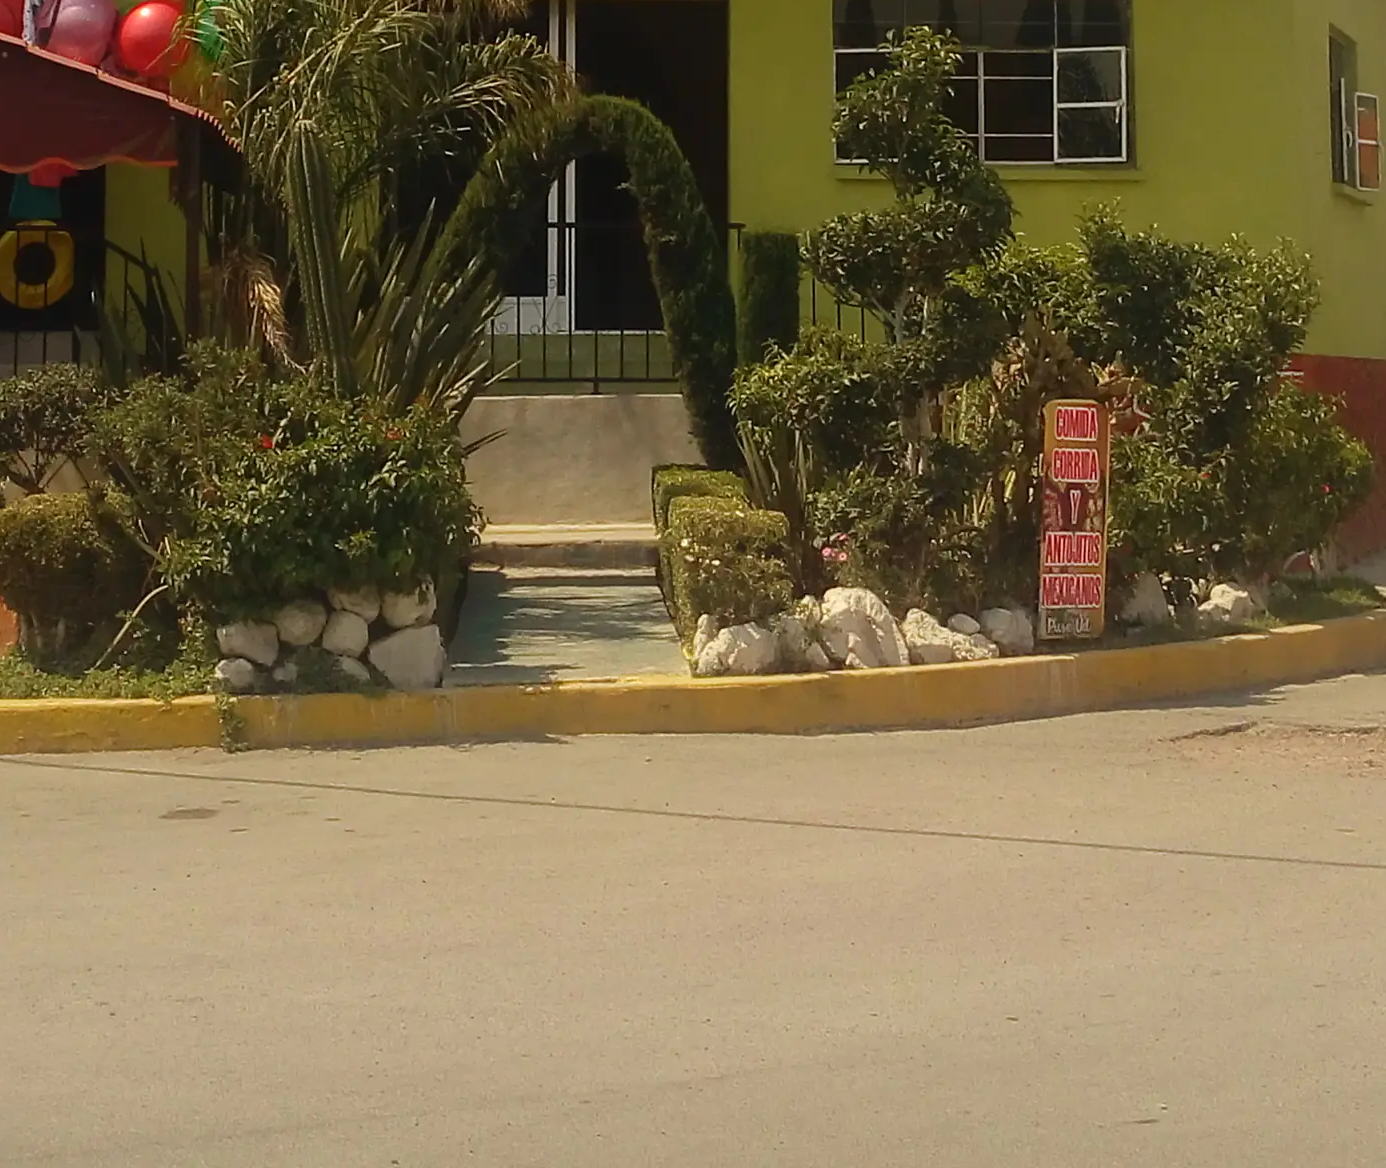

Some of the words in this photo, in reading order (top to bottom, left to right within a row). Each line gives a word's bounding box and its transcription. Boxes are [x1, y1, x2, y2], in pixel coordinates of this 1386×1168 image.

[1054, 406, 1098, 441] COMIDA
[1052, 448, 1100, 483] CORRIDA
[1069, 489, 1082, 525] Y
[1045, 532, 1102, 566] ANTOJITOS
[1041, 574, 1102, 608] MEXICANOS
